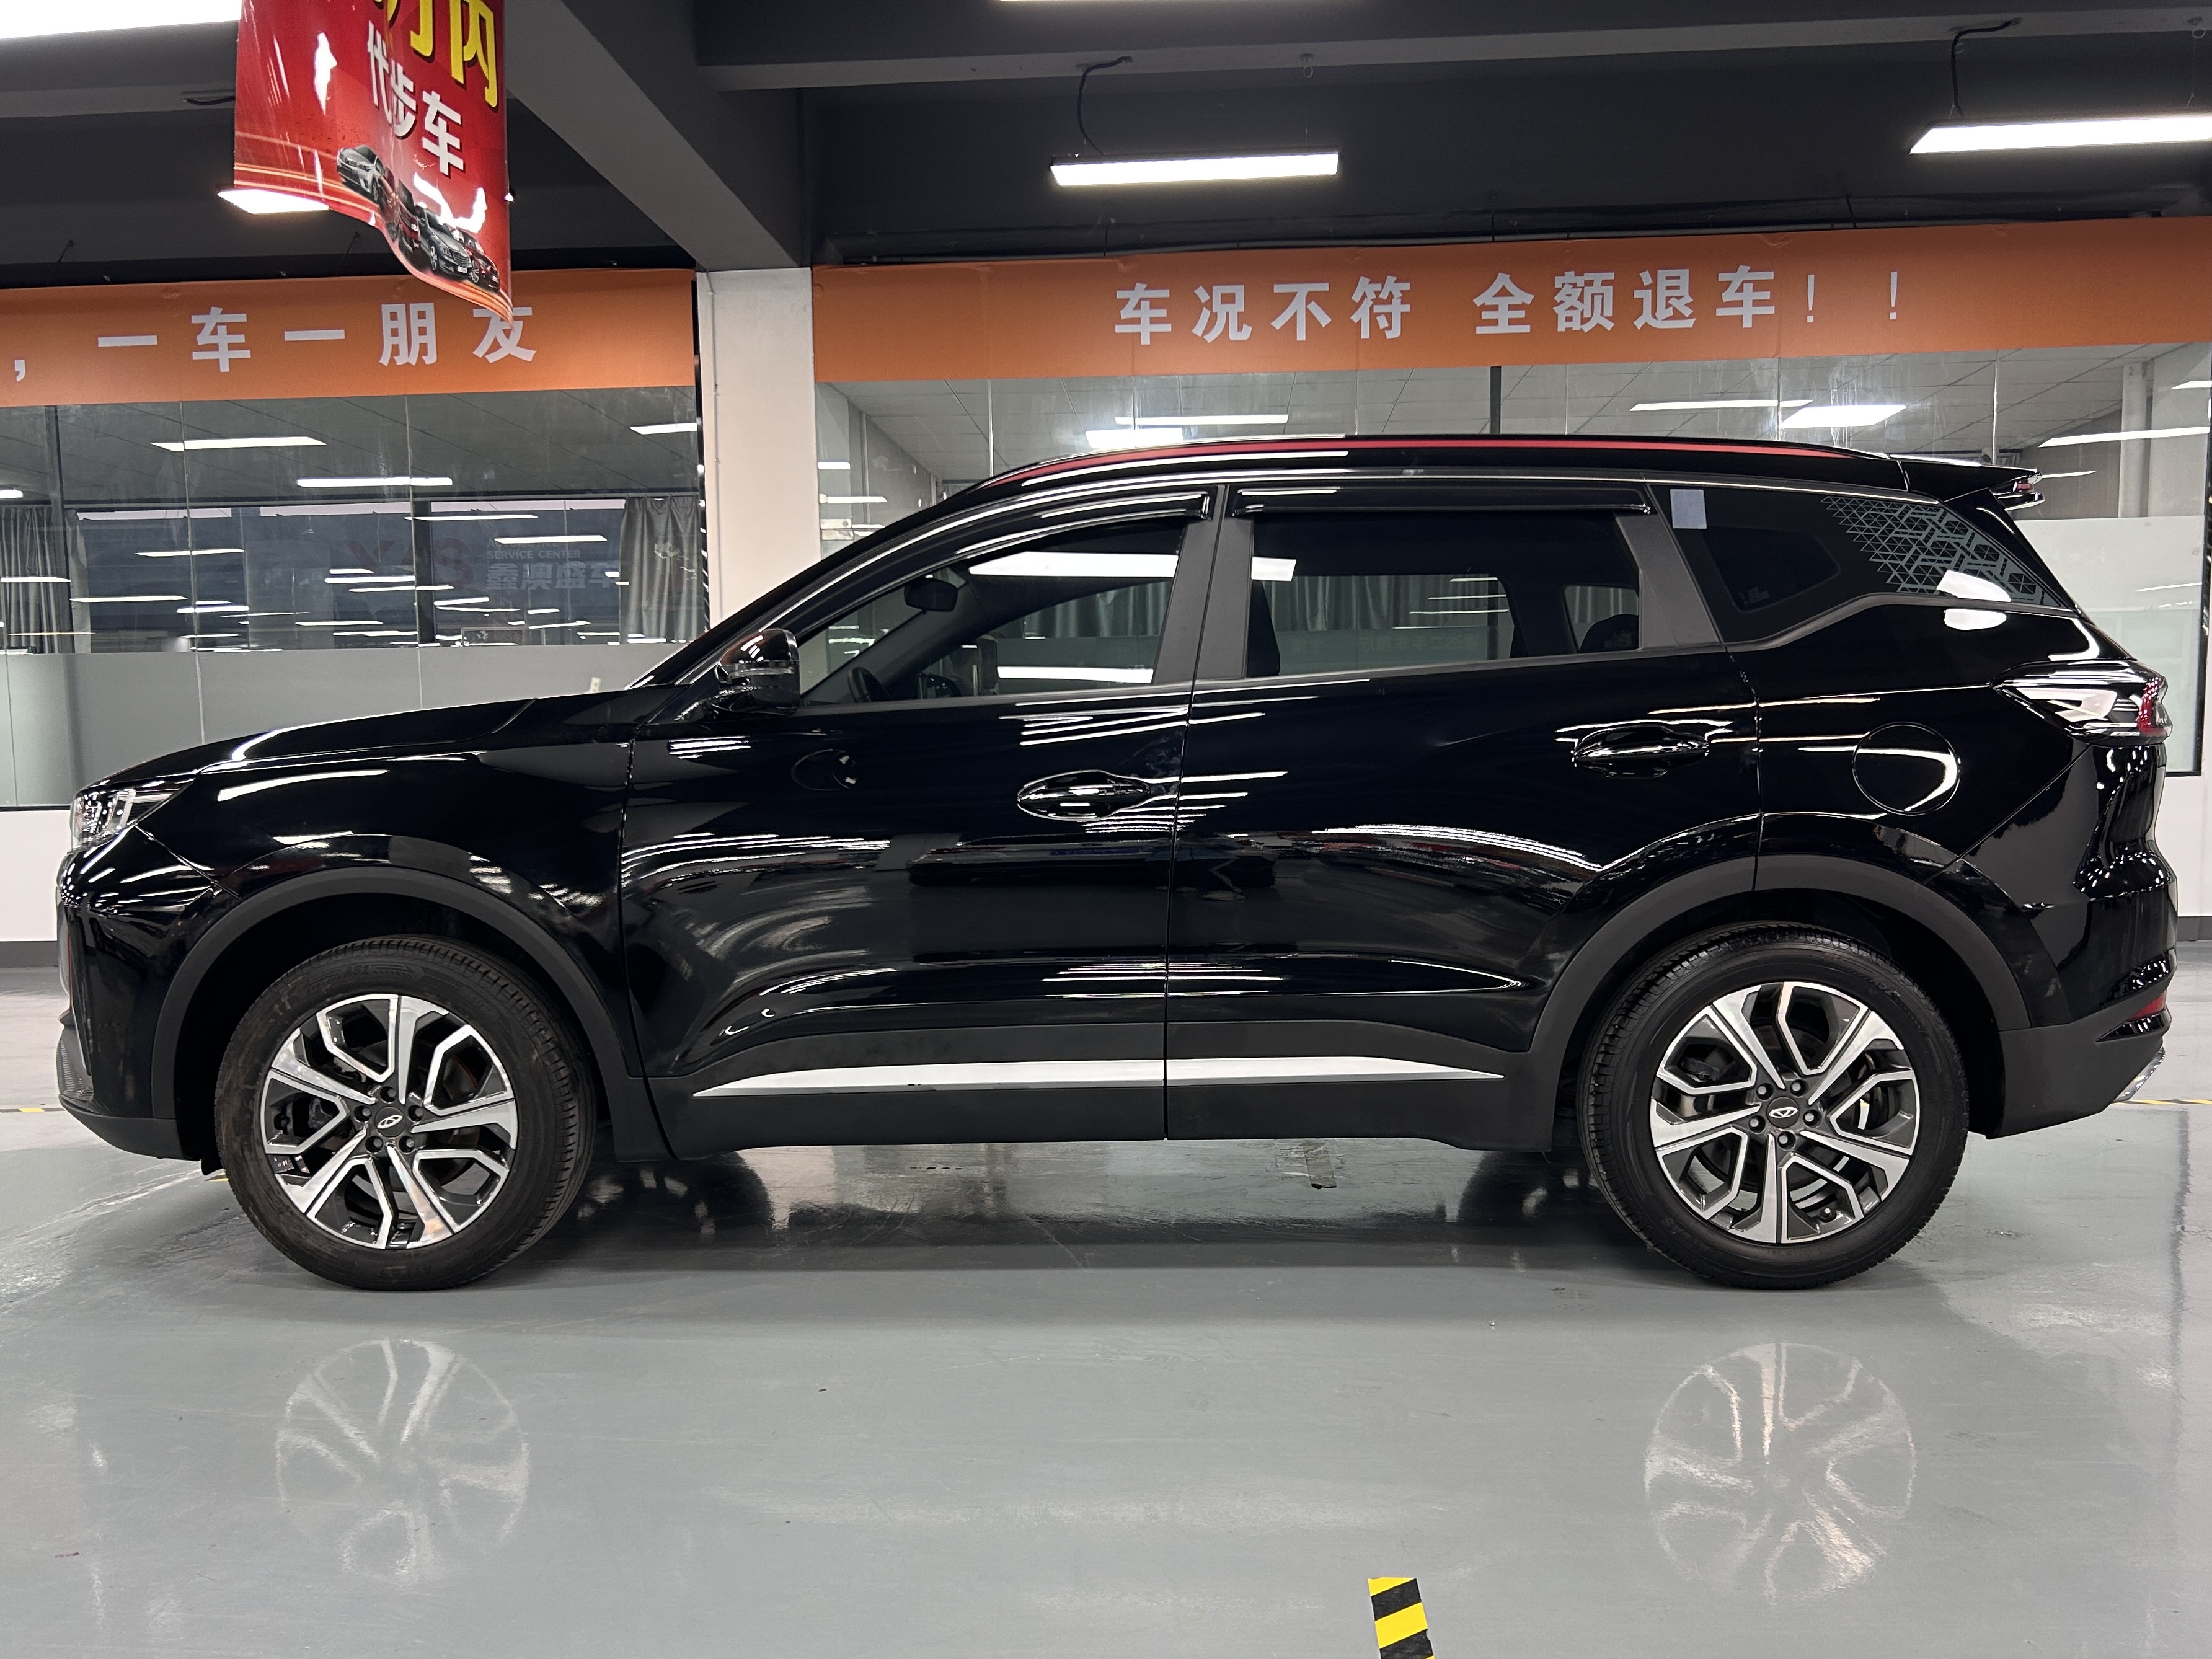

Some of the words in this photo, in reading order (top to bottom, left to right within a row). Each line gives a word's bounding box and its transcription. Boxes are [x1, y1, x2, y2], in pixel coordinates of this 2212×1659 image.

[368, 20, 464, 176] 代步车
[1115, 276, 1411, 345] 车况不符
[487, 549, 534, 559] SERVICE
[538, 549, 581, 559] CENTER
